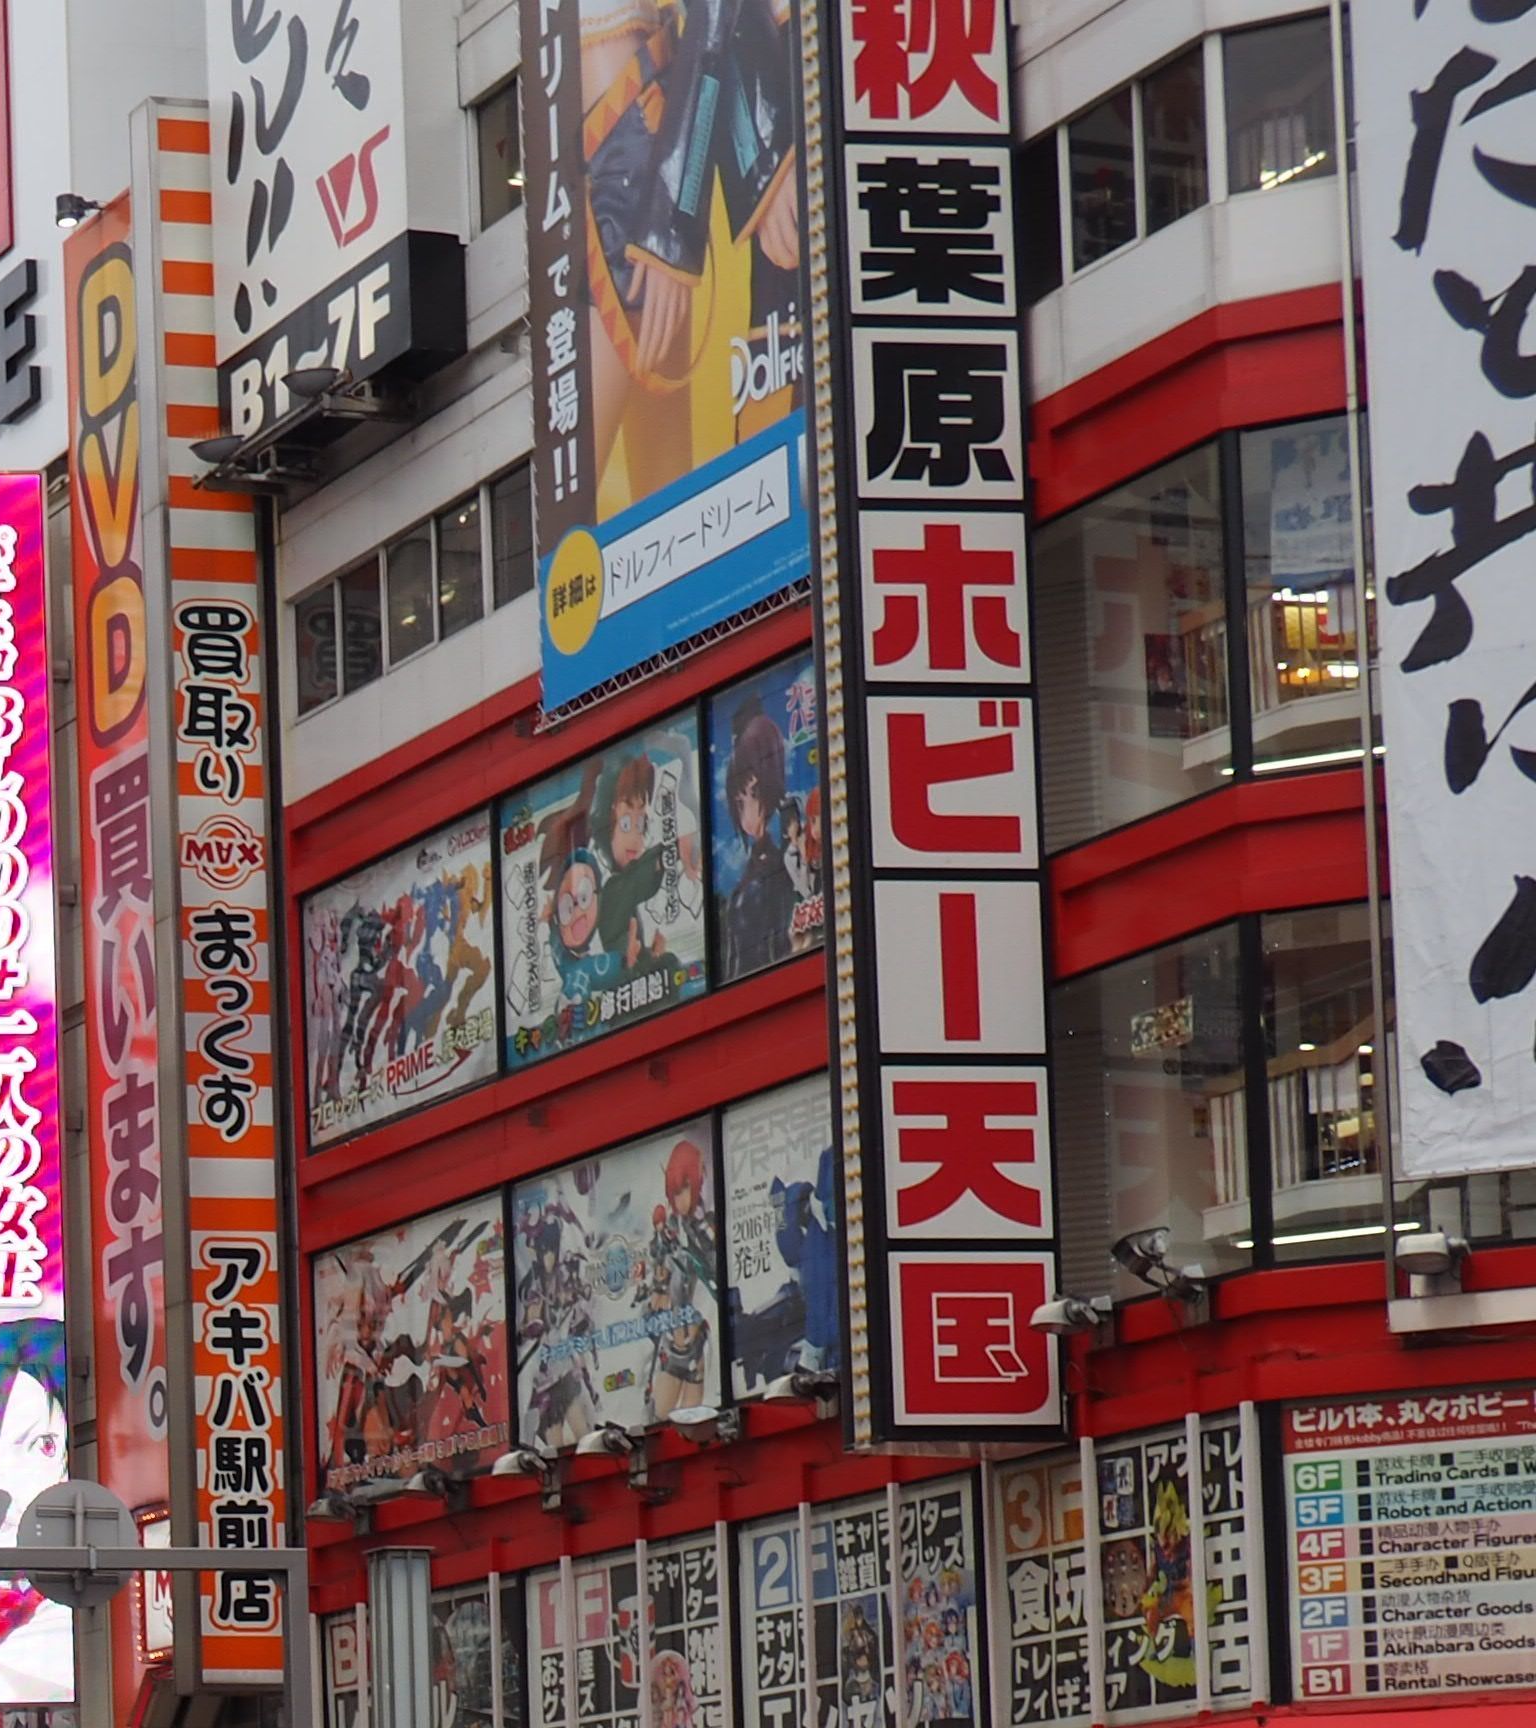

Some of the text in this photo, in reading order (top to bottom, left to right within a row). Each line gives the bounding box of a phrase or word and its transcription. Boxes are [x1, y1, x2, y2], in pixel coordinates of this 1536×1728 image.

[607, 478, 777, 601] ドルフィードリーム
[179, 606, 254, 801] 買取り
[192, 906, 256, 1141] まっくす
[386, 1041, 435, 1089] PRIME
[205, 1245, 271, 1623] アキバ駅前店
[1295, 1462, 1342, 1492] 6F
[1376, 1465, 1499, 1486] Trading Cards
[1297, 1497, 1343, 1525] 5F
[1378, 1498, 1533, 1521] Robot and Action
[1298, 1531, 1343, 1558] 4F
[1378, 1536, 1469, 1555] Character
[1300, 1564, 1345, 1593] 3F
[1380, 1568, 1490, 1590] Secondhand
[1302, 1600, 1347, 1626] 2F
[1382, 1601, 1534, 1624] Character Goods
[1307, 1633, 1348, 1660] 1F
[1383, 1635, 1536, 1658] Akihabara Goods
[1308, 1668, 1345, 1694] B1
[1385, 1676, 1442, 1692] Rental
